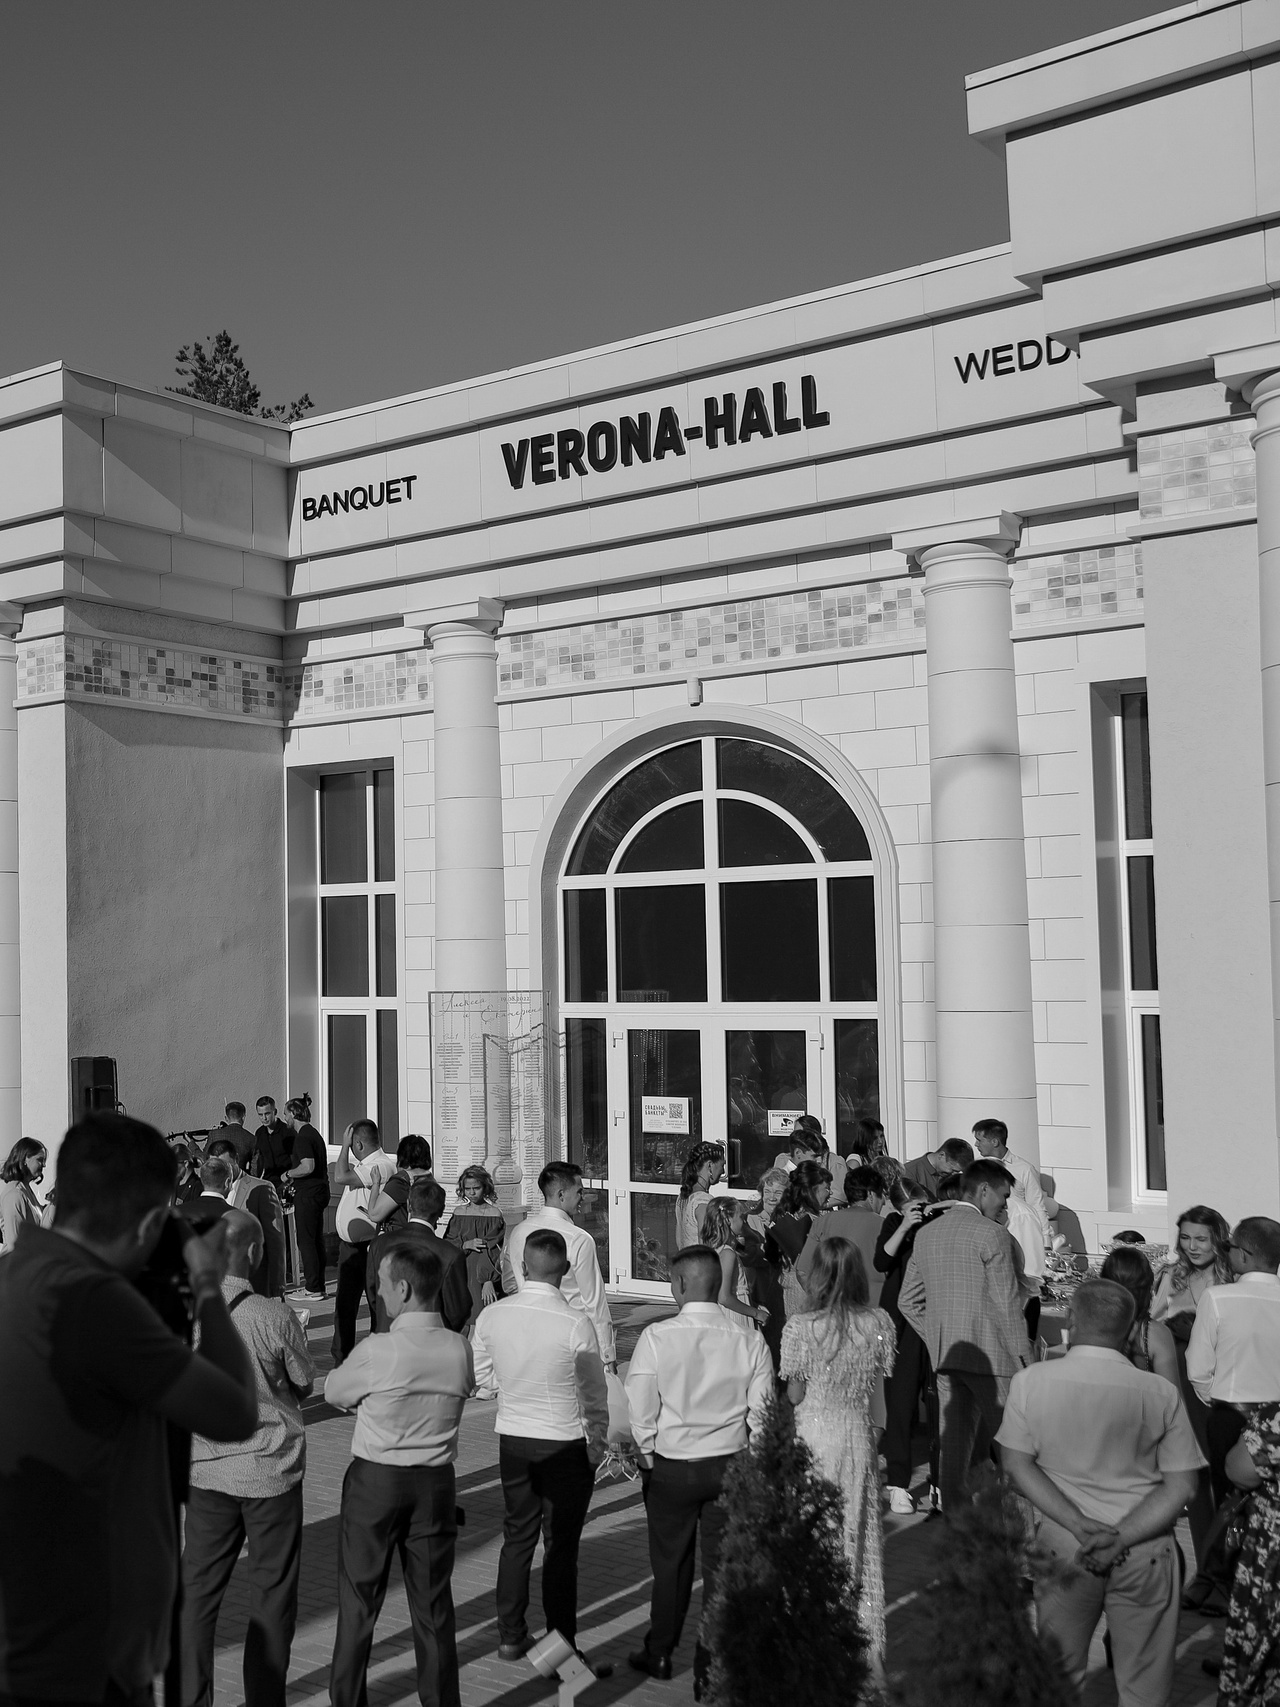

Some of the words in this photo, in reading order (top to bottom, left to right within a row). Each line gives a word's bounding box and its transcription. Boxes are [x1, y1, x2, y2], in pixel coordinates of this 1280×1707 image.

[953, 335, 1080, 384] WEDD
[500, 375, 830, 490] VERONA-HALL
[302, 475, 417, 521] BANQUET
